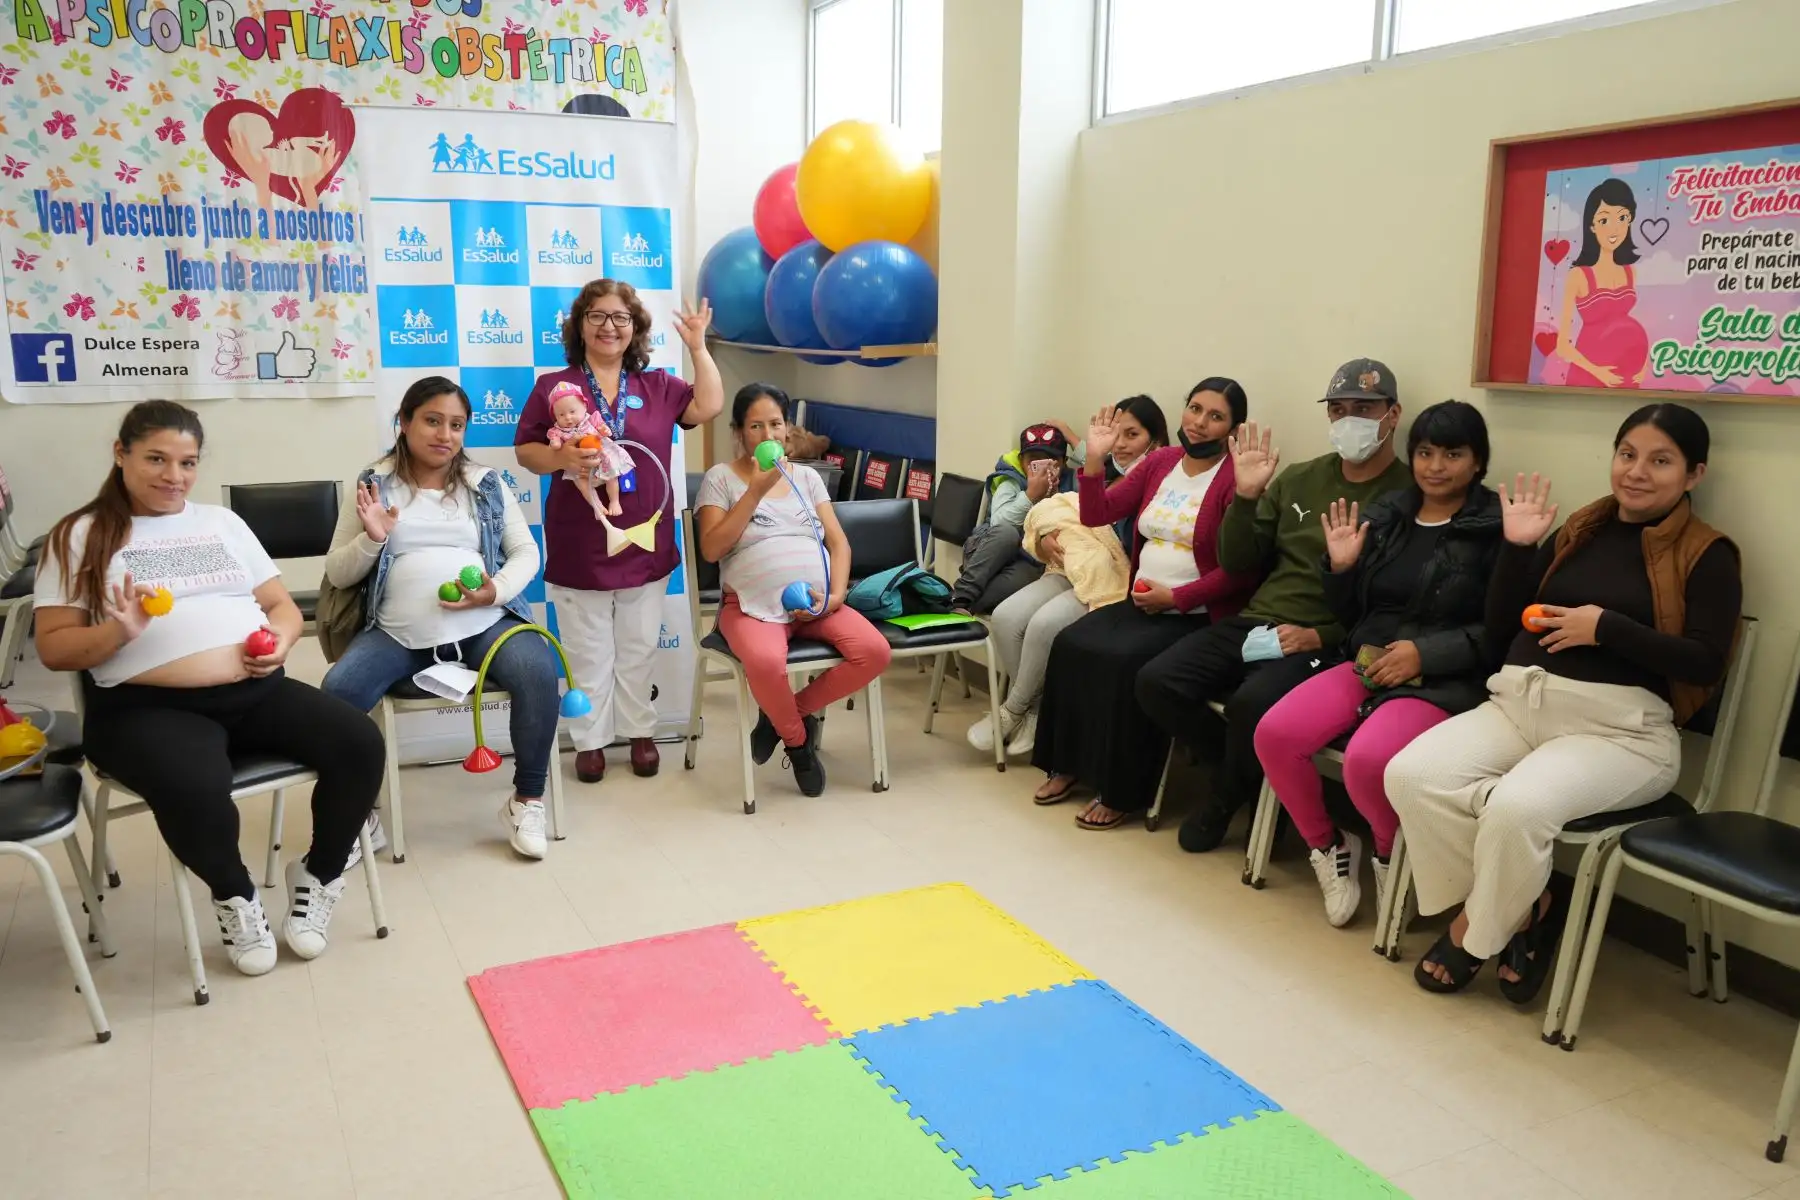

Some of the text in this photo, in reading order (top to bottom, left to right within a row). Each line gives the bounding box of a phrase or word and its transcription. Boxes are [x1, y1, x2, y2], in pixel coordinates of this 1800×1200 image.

[14, 0, 648, 94] A PSICOPROFILAXIS OBSTÉTRICA
[498, 149, 615, 181] EsSalud
[1691, 193, 1722, 220] Tu
[33, 188, 354, 249] Ven y descubre junto a nosotros
[1702, 230, 1794, 253] Prepárate
[384, 247, 443, 263] EsSalud
[462, 248, 519, 264] EsSalud
[538, 249, 593, 265] EsSalud
[611, 252, 663, 268] EsSalud
[1687, 256, 1728, 275] para
[1734, 252, 1749, 270] el
[165, 249, 216, 292] lleno
[221, 251, 246, 293] de
[251, 260, 301, 293] amor
[304, 261, 318, 302] y
[1717, 274, 1737, 291] de
[1745, 274, 1765, 290] tu
[1700, 306, 1774, 338] Sala
[85, 336, 200, 355] Dulce Espera
[389, 329, 448, 345] EsSalud
[467, 329, 523, 344] EsSalud
[102, 362, 189, 377] Almenara
[471, 410, 521, 425] EsSalu
